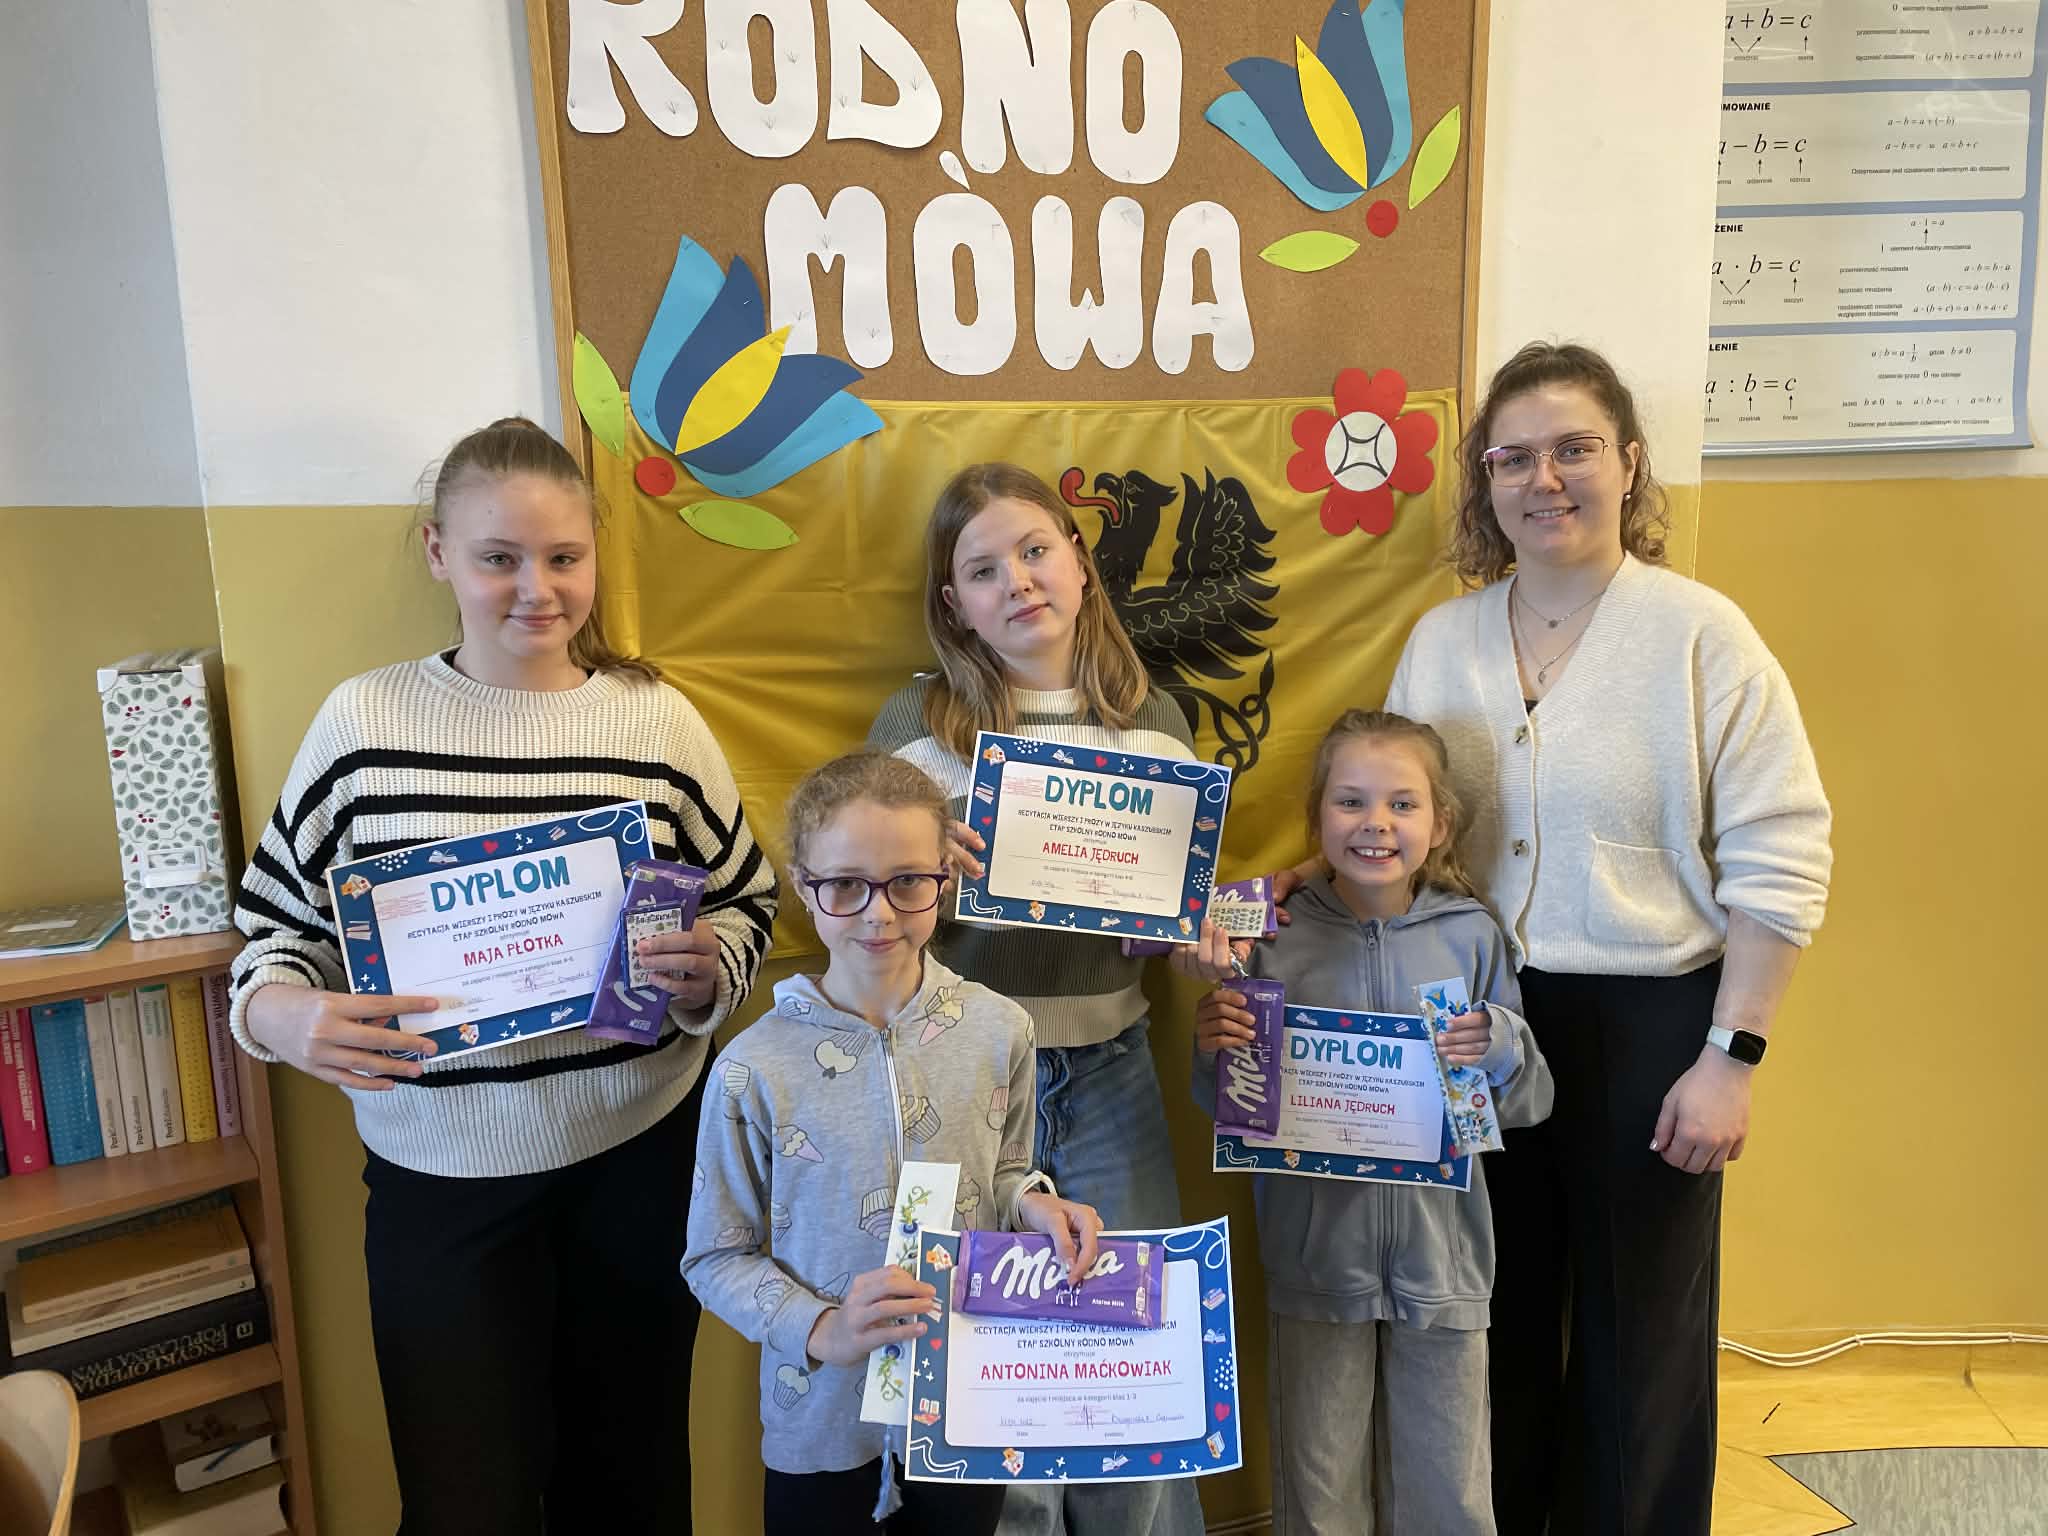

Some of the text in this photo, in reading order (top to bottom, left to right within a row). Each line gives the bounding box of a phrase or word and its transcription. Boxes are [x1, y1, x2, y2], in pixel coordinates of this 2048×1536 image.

[1721, 102, 1771, 112] MOWANIE
[1749, 254, 1762, 274] b
[1789, 259, 1801, 273] c
[1709, 343, 1738, 352] LENIE
[1705, 380, 1717, 394] a
[1744, 372, 1757, 393] b
[1784, 377, 1797, 392] c
[1044, 774, 1154, 816] DYPLOM
[1042, 841, 1139, 865] AMELIA JĘDRUCH
[430, 855, 571, 913] DYPLOM
[555, 890, 602, 907] KASZUBSKIM
[463, 933, 564, 967] MAJA PŁOTKA
[1290, 1035, 1403, 1070] DYPLOM
[1226, 1046, 1267, 1113] Mil
[1290, 1095, 1396, 1115] LILIANA JĘDRUCH
[990, 1245, 1125, 1300] Mia
[1017, 1339, 1038, 1349] ETAP
[1039, 1338, 1075, 1349] SZKOLNY
[1077, 1337, 1106, 1348] RODNO
[981, 1358, 1172, 1381] ANTONINA MAĆKOWIAK
